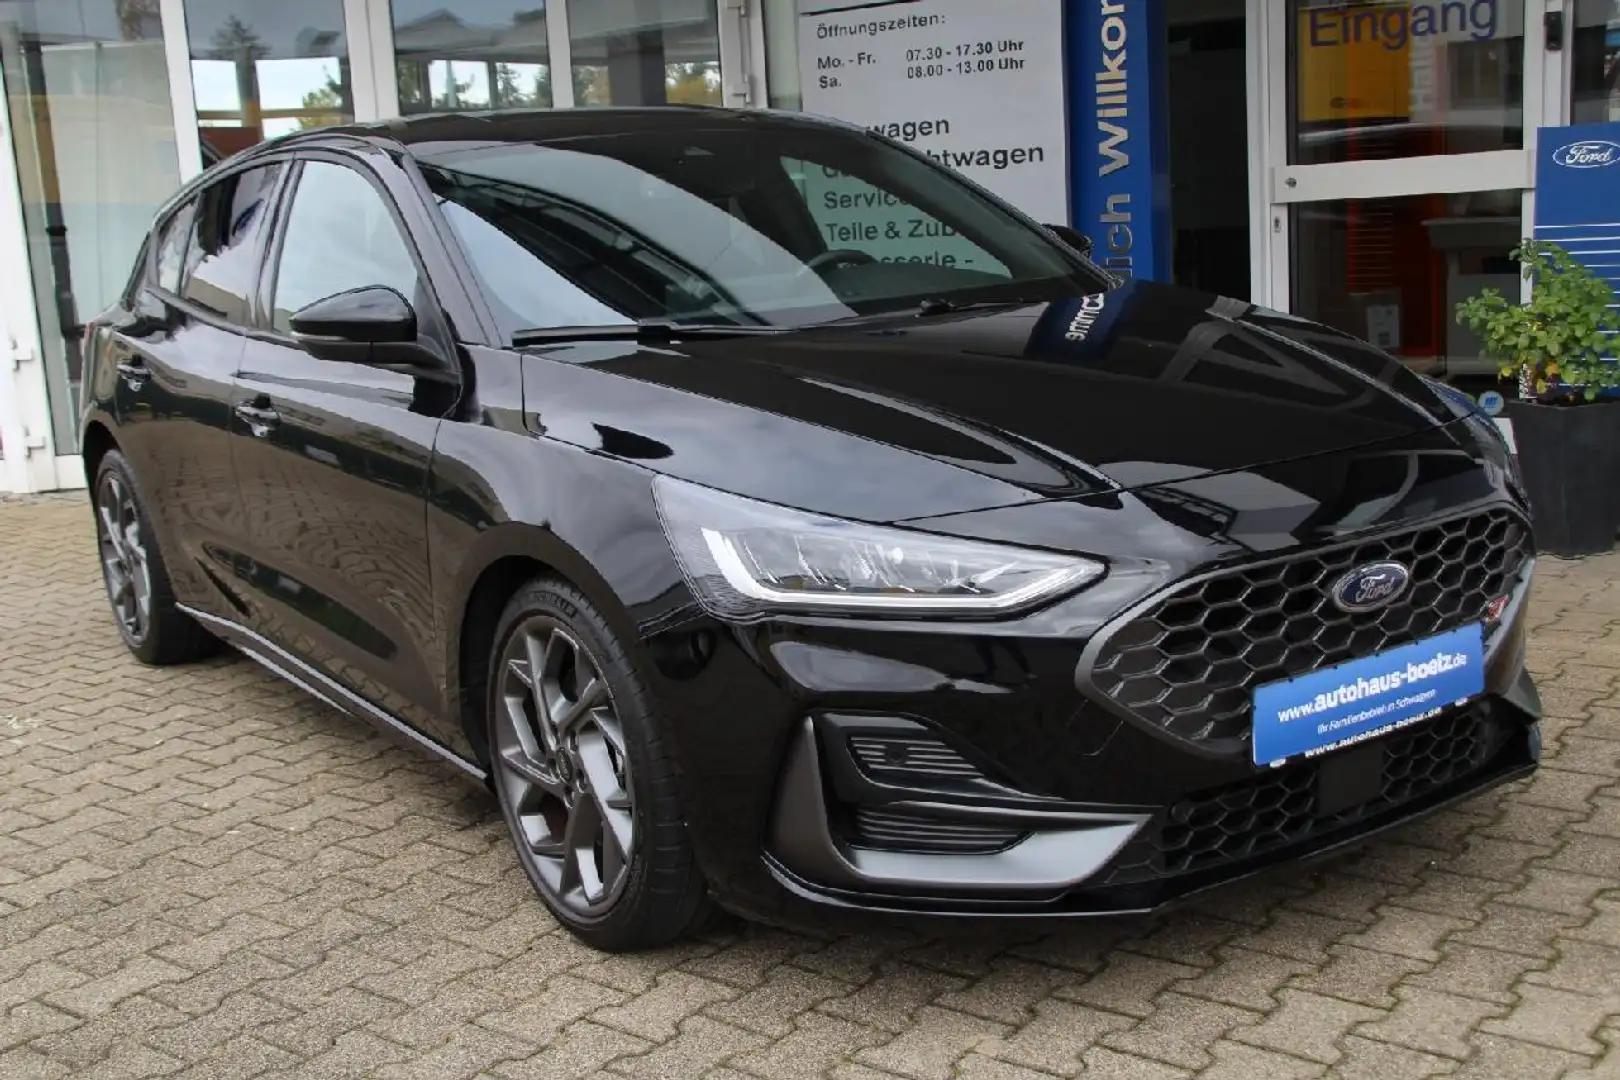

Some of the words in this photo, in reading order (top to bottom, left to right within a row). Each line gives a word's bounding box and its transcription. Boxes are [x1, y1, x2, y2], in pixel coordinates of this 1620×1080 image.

[816, 14, 946, 40] Öffnungszeiten:
[1310, 0, 1497, 50] Eingang
[817, 55, 845, 70] Mo.
[857, 52, 877, 66] Fr.
[906, 47, 943, 62] 07.30
[955, 41, 994, 56] 17.30
[997, 39, 1025, 53] Uhr
[818, 75, 842, 89] Sa.
[907, 64, 944, 79] 08.00
[955, 59, 995, 74] 13.00
[998, 57, 1026, 71] Uhr
[1565, 145, 1613, 164] Ford
[823, 189, 911, 209] Servic
[825, 221, 879, 242] Teile
[884, 221, 901, 240] &
[1355, 573, 1396, 603] Ford
